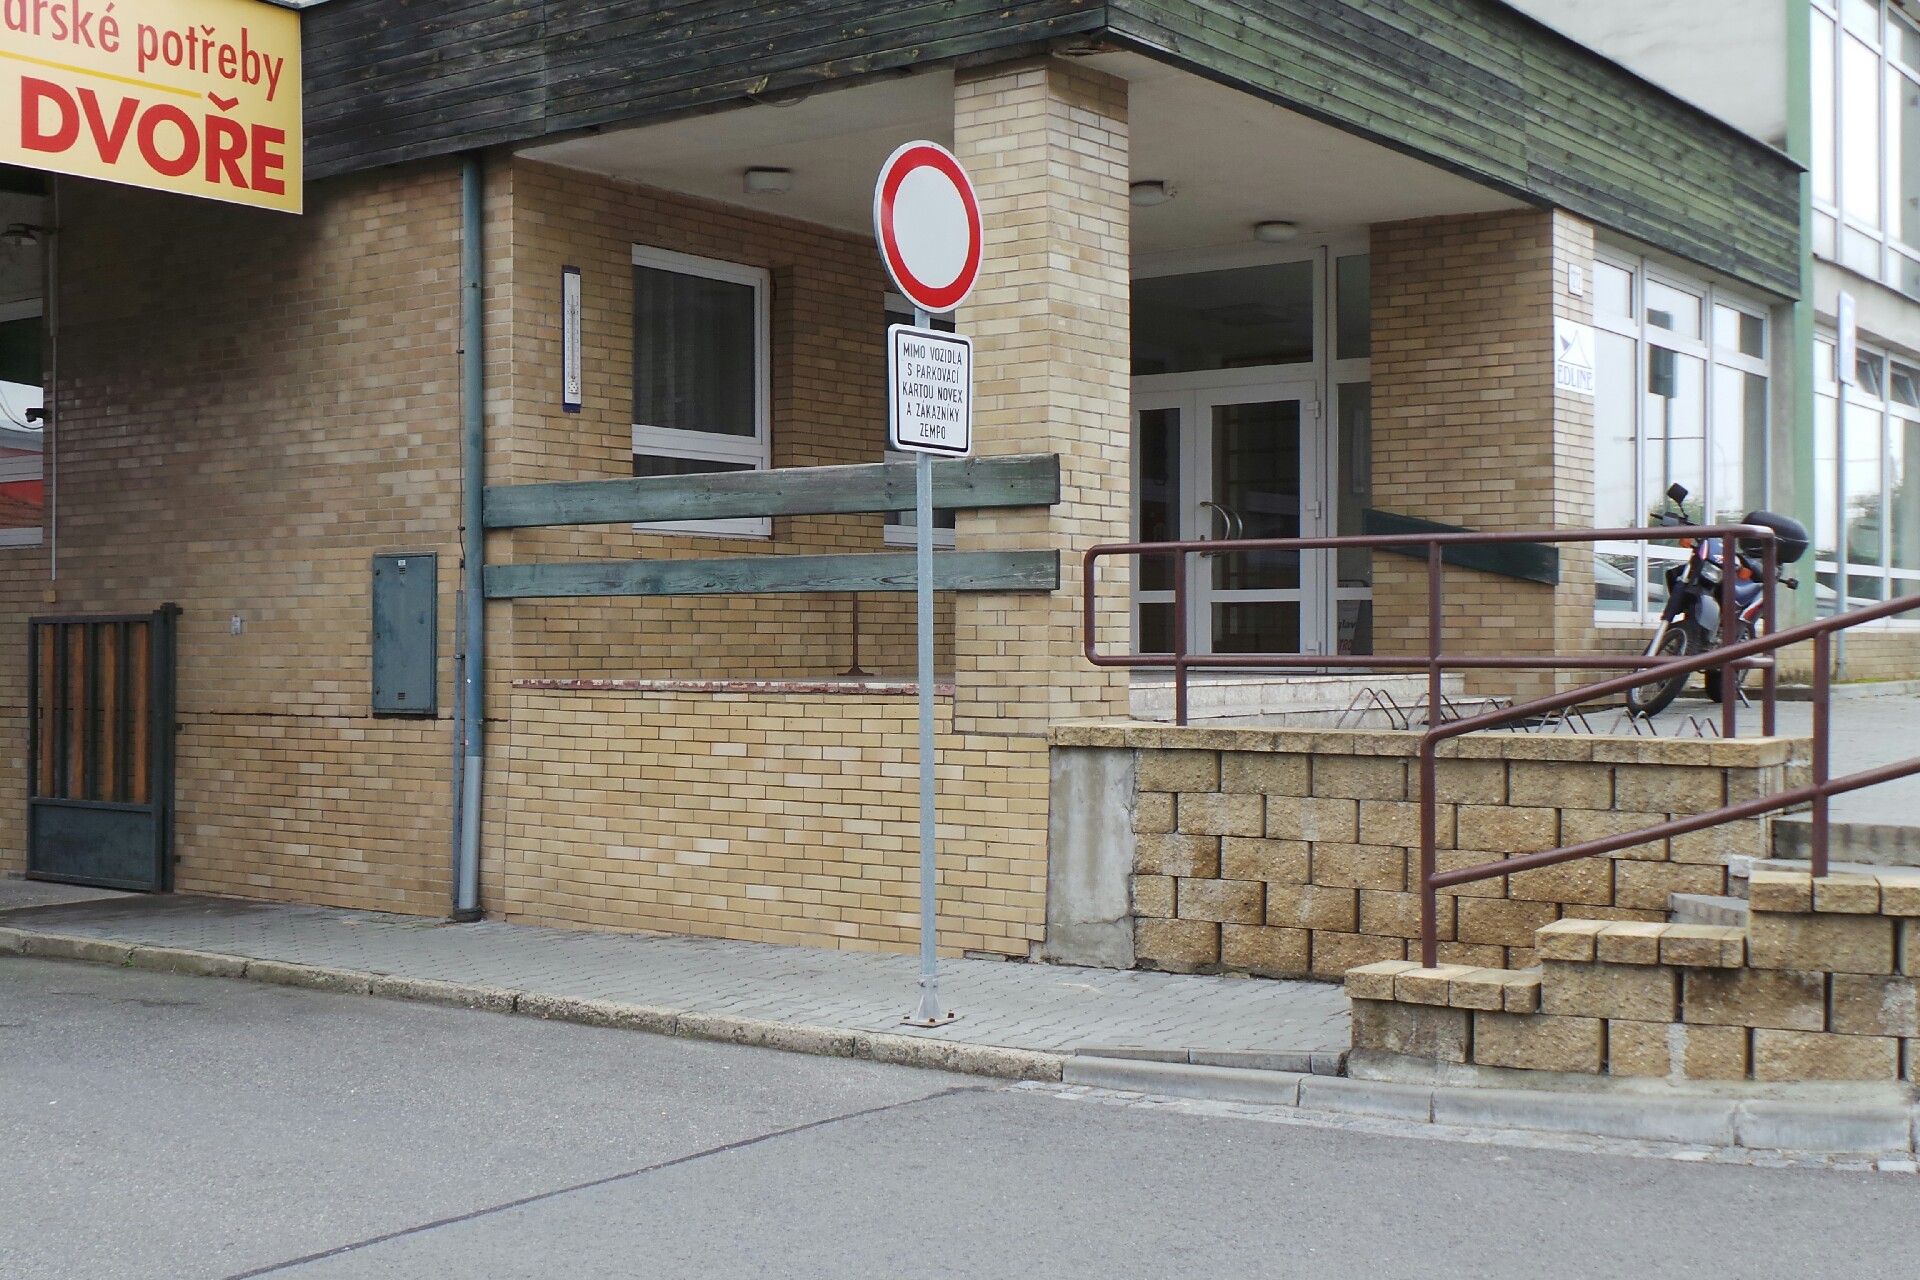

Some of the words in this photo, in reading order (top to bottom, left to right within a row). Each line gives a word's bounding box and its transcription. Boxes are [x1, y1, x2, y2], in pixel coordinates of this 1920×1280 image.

[137, 23, 284, 102] potřeby
[21, 75, 285, 195] DVOŘE
[903, 342, 926, 359] MIMO
[930, 347, 962, 365] VOZIDLA
[907, 363, 912, 377] S
[916, 364, 959, 384] PARKOVACÍ
[902, 381, 933, 399] KARTOU
[937, 387, 963, 404] NOVEX
[906, 402, 912, 416] A
[916, 400, 960, 422] ZÁKAZNÍKY
[919, 423, 946, 440] ZEMPO
